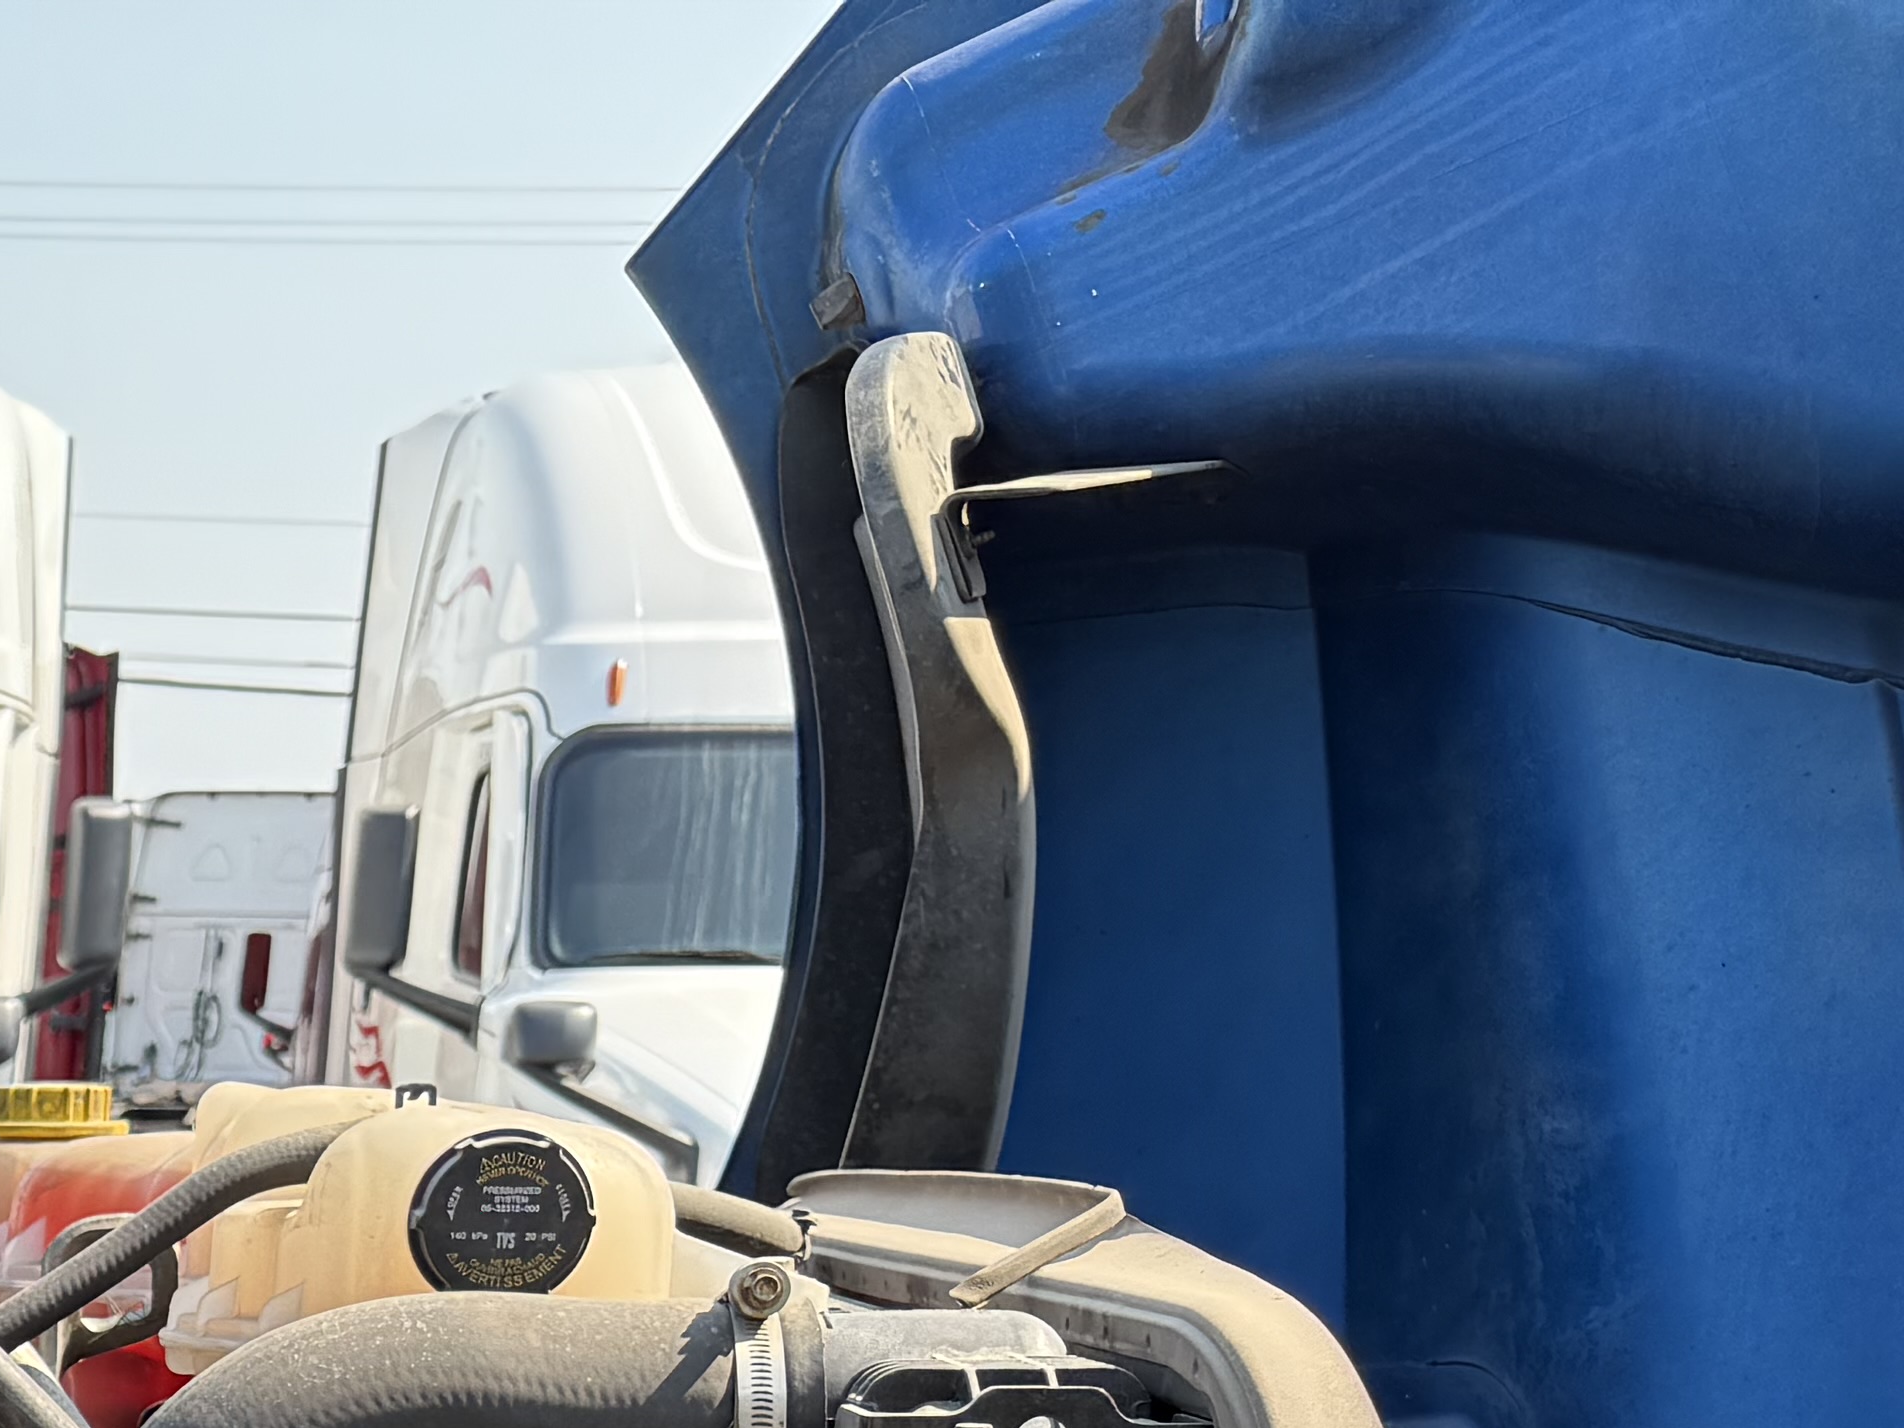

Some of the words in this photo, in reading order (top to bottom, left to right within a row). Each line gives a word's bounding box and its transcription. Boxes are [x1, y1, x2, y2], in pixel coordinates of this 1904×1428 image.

[491, 1151, 546, 1171] CAUTION
[482, 1186, 542, 1195] PRESSURIZED
[494, 1196, 529, 1204] SYSTEM
[496, 1232, 517, 1249] TVS
[524, 1232, 537, 1241] 20
[541, 1232, 557, 1241] PSI
[453, 1243, 567, 1288] AVERTISSEMENT
